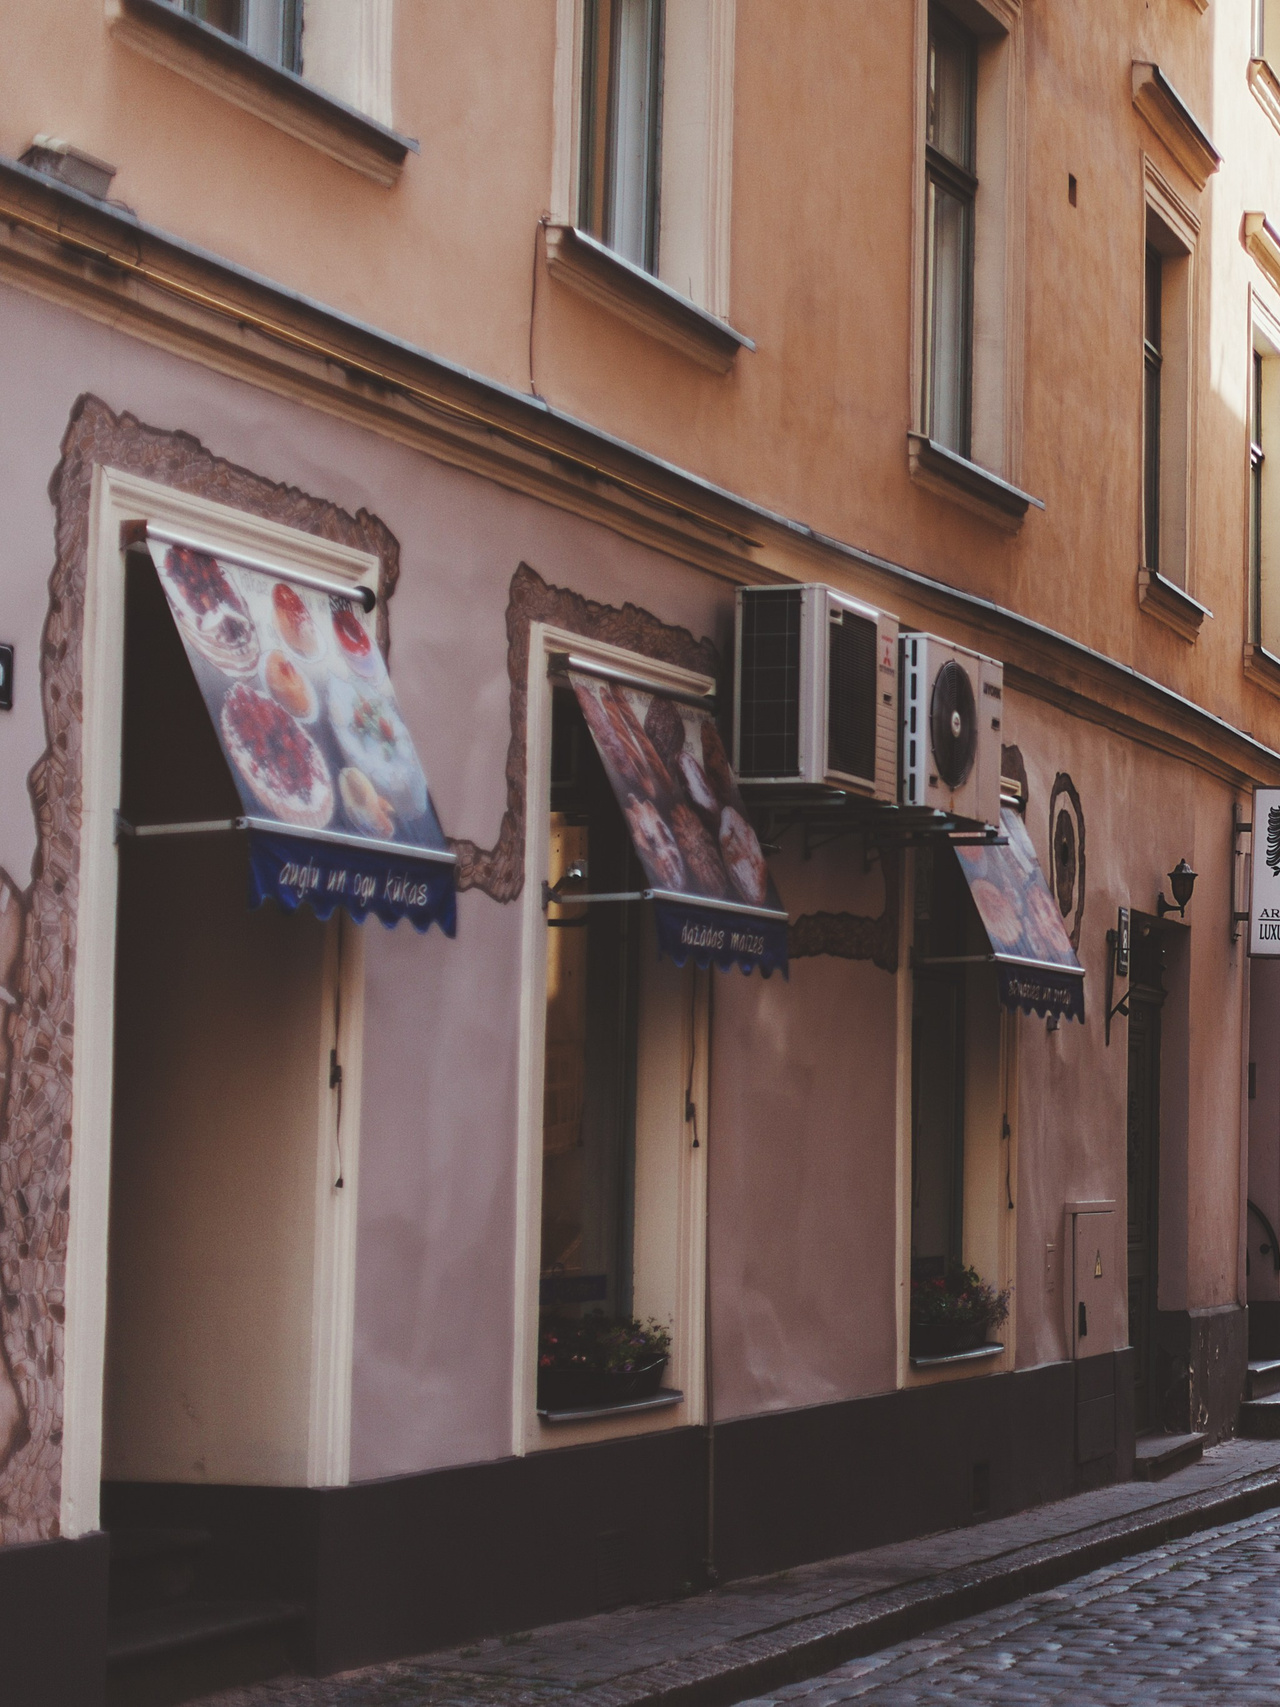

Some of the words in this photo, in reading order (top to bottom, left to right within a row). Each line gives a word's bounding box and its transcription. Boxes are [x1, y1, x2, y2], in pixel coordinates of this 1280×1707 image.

[327, 869, 347, 893] un
[353, 872, 376, 907] ogu
[383, 869, 429, 906] kūkas
